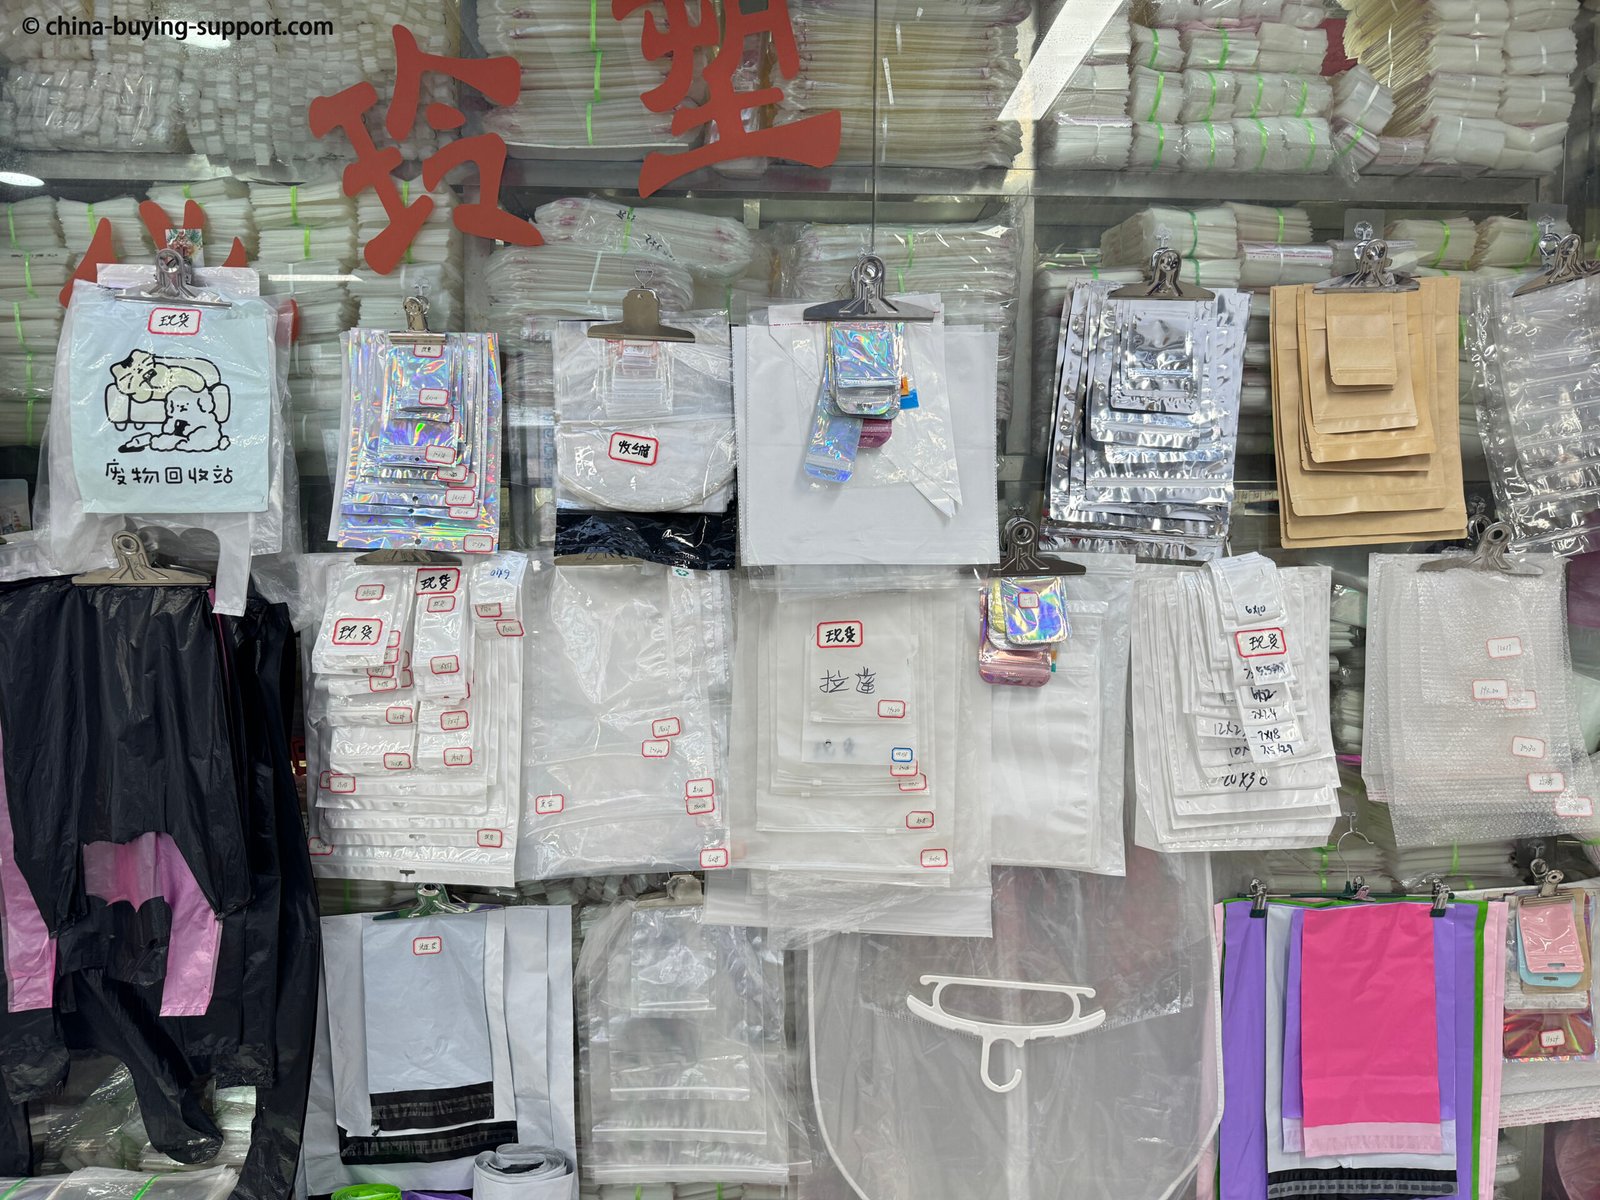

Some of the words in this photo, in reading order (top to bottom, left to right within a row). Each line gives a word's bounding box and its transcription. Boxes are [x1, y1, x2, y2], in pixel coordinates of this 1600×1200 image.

[158, 312, 190, 329] 现货
[618, 439, 652, 459] 收缩
[105, 458, 234, 486] 废物回收站
[420, 573, 452, 591] 现货
[825, 625, 857, 644] 现货
[1248, 633, 1280, 651] 现货
